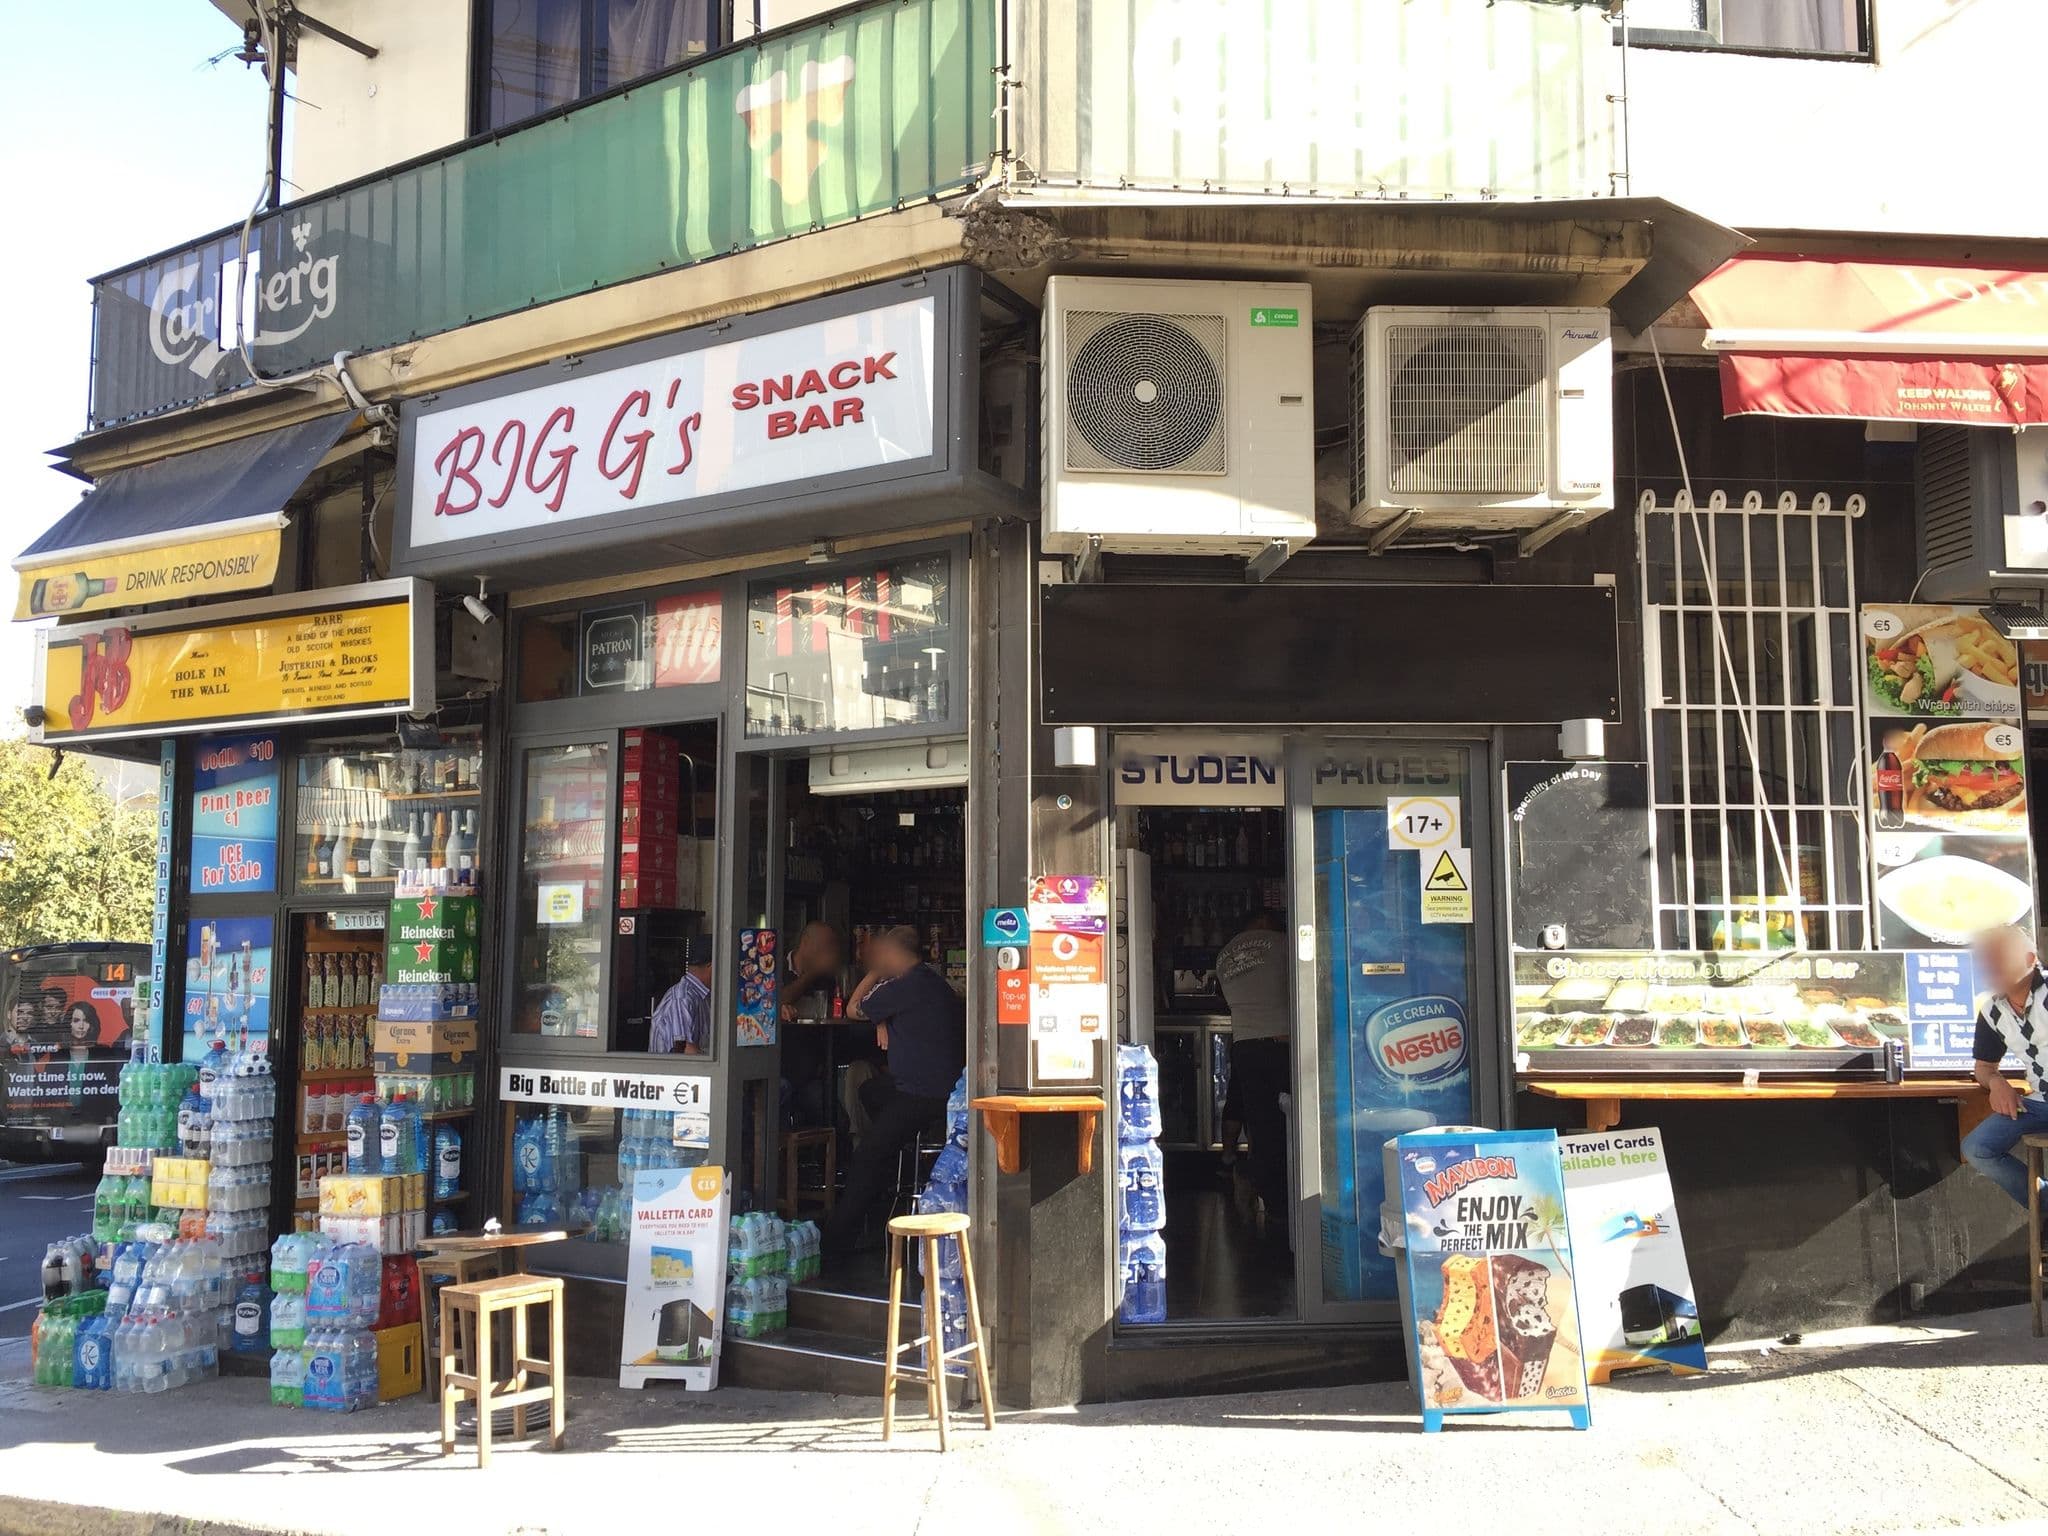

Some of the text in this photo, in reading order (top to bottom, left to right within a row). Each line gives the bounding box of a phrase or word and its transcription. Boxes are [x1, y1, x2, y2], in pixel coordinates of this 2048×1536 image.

[1562, 329, 1599, 339] Airwell
[732, 352, 897, 410] SNACK
[768, 398, 865, 440] BAR
[434, 378, 702, 517] BIG G's
[126, 554, 259, 591] DRINK RESPONSIBLY
[314, 613, 343, 627] RARE
[1873, 620, 1890, 631] €5
[175, 666, 226, 682] HOLE IN
[171, 683, 230, 699] THE WALL
[1917, 699, 2016, 713] Wrap with chips
[1995, 735, 2012, 746] €5
[201, 787, 271, 814] Pint Beer
[1513, 768, 1602, 822] Speciality of the Day
[225, 810, 240, 828] €1
[1406, 816, 1443, 833] 17+
[219, 843, 243, 865] ICE
[202, 860, 262, 886] For Sale
[400, 925, 455, 939] Heineken
[106, 964, 125, 982] 14
[397, 969, 451, 983] Heineken
[1815, 958, 1859, 979] Bar
[1001, 992, 1026, 1001] Top-up
[1006, 1002, 1022, 1010] here
[1383, 1004, 1446, 1028] ICE CREAM
[30, 1045, 59, 1054] STARS
[1383, 1025, 1462, 1067] Nestlé
[8, 1071, 107, 1083] Your time is now.
[8, 1086, 44, 1097] Watch
[45, 1085, 81, 1096] series
[82, 1086, 98, 1096] on
[509, 1074, 700, 1106] Big Bottle of Water €1
[1566, 1135, 1655, 1154] Travel Cards
[1562, 1151, 1658, 1171] ailable here
[1423, 1156, 1518, 1209] MAXIBON
[638, 1208, 713, 1221] VALLETTA CARD
[1457, 1195, 1522, 1222] ENJOY
[1464, 1224, 1482, 1236] THE
[1486, 1223, 1529, 1249] MIX
[1441, 1238, 1484, 1251] PERFECT
